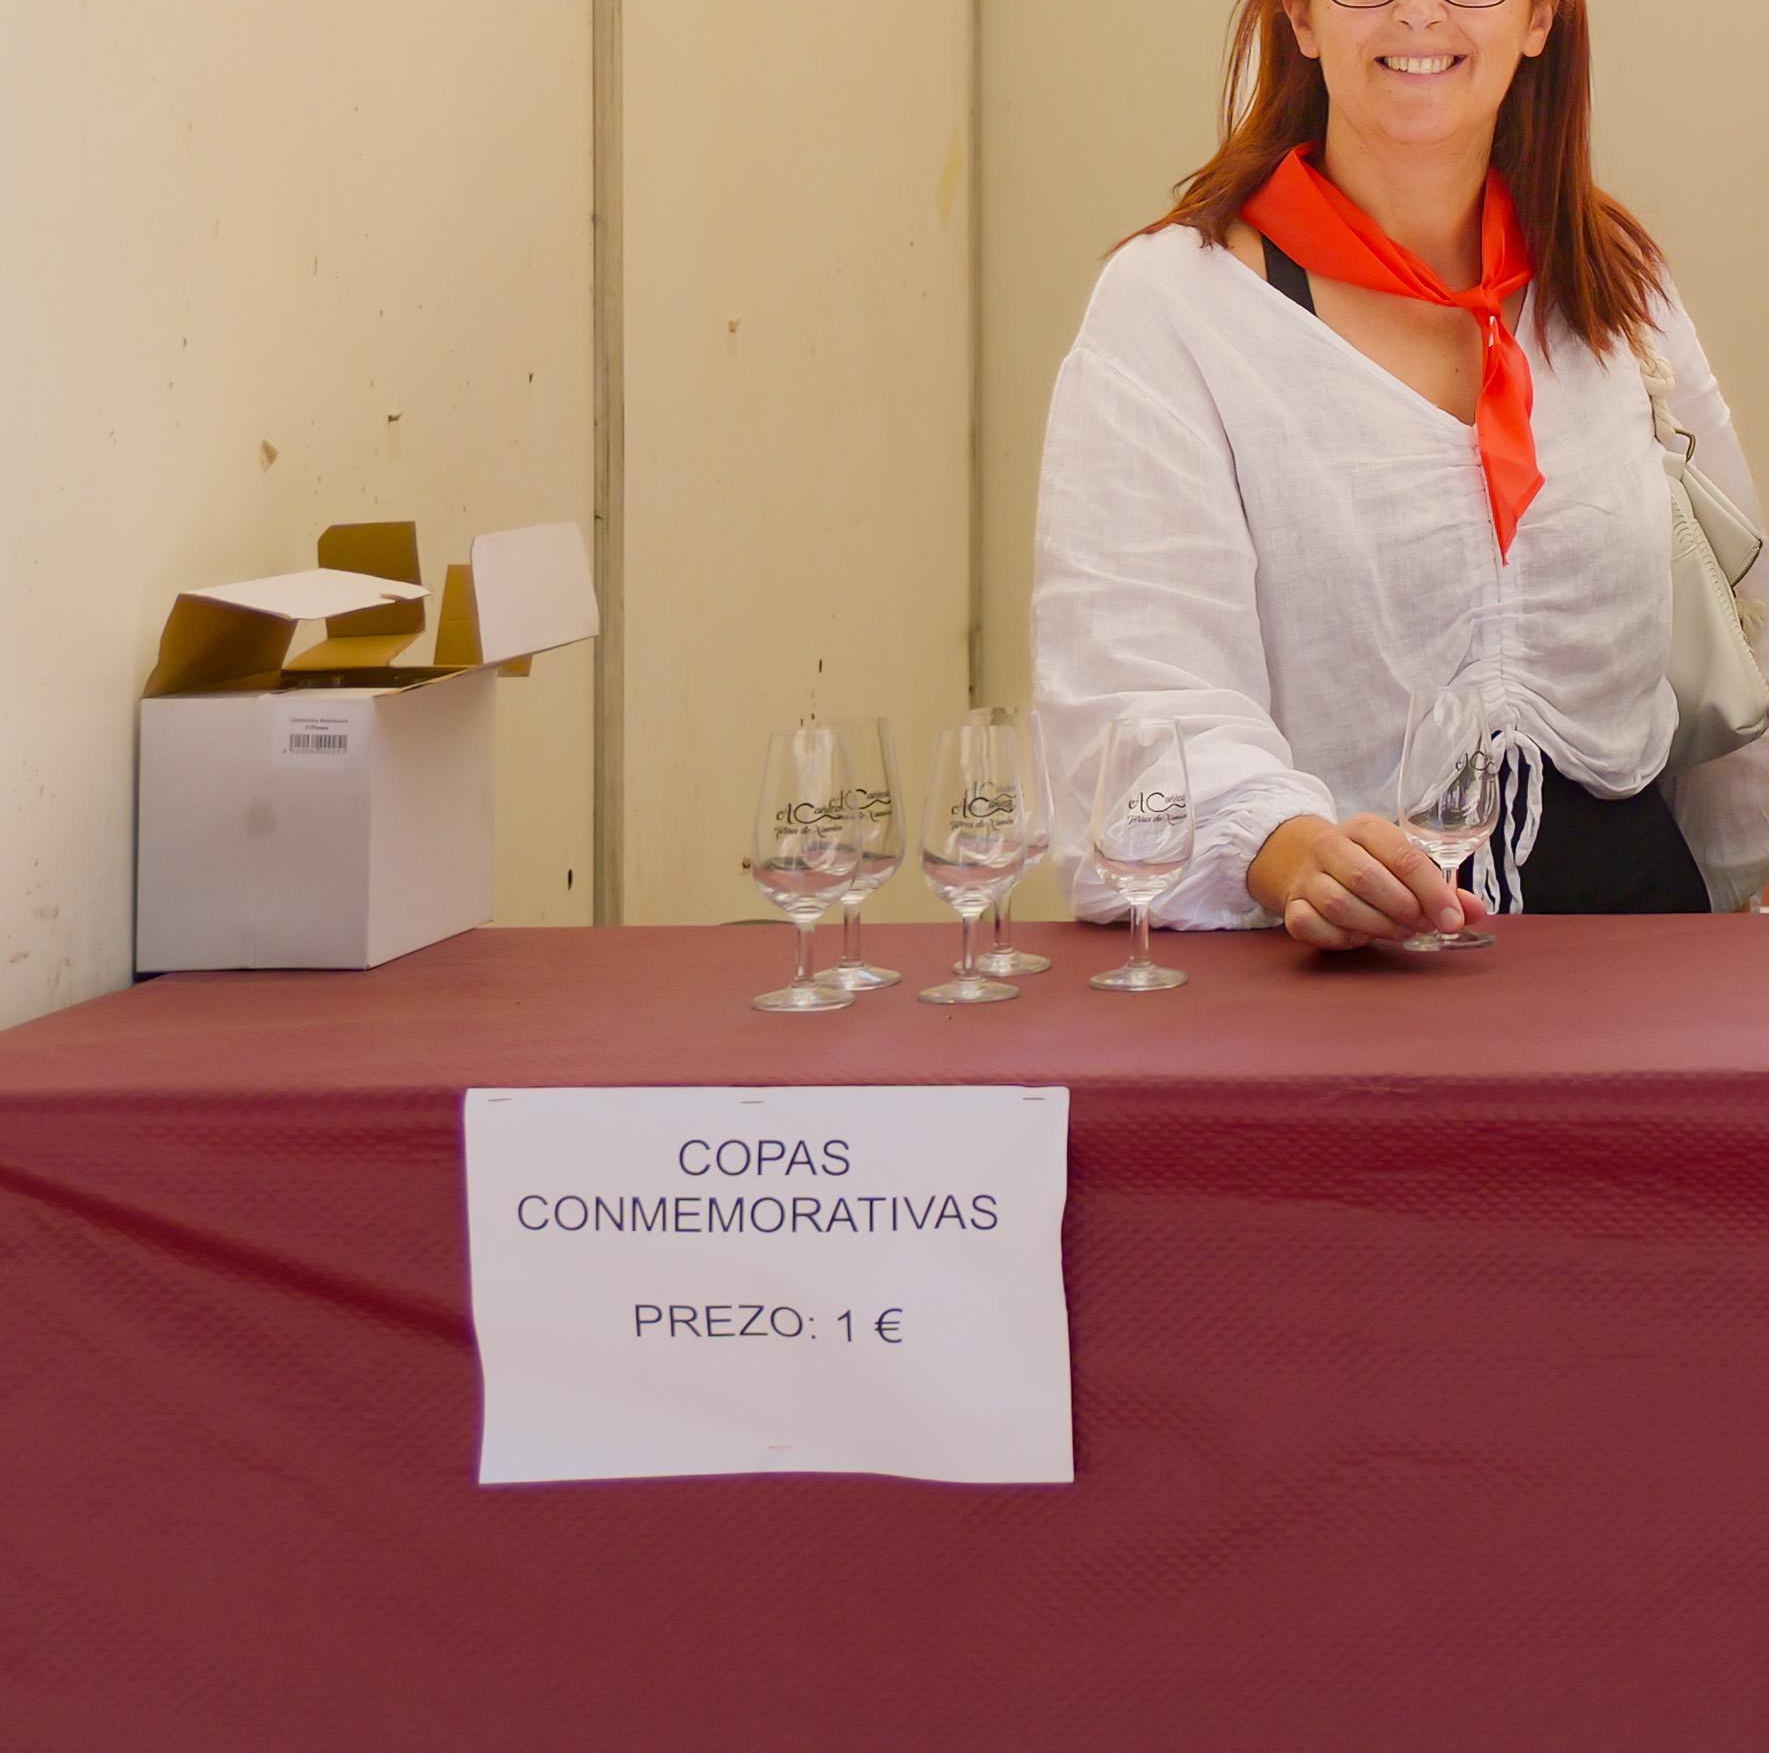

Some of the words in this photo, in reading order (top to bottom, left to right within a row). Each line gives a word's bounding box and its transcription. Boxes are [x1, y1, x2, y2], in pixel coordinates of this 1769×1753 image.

[678, 1139, 851, 1177] COPAS
[517, 1193, 999, 1234] CONMEMORATIVAS
[634, 1303, 817, 1340] PREZO:
[837, 1309, 854, 1343] 1
[874, 1307, 903, 1344] €
